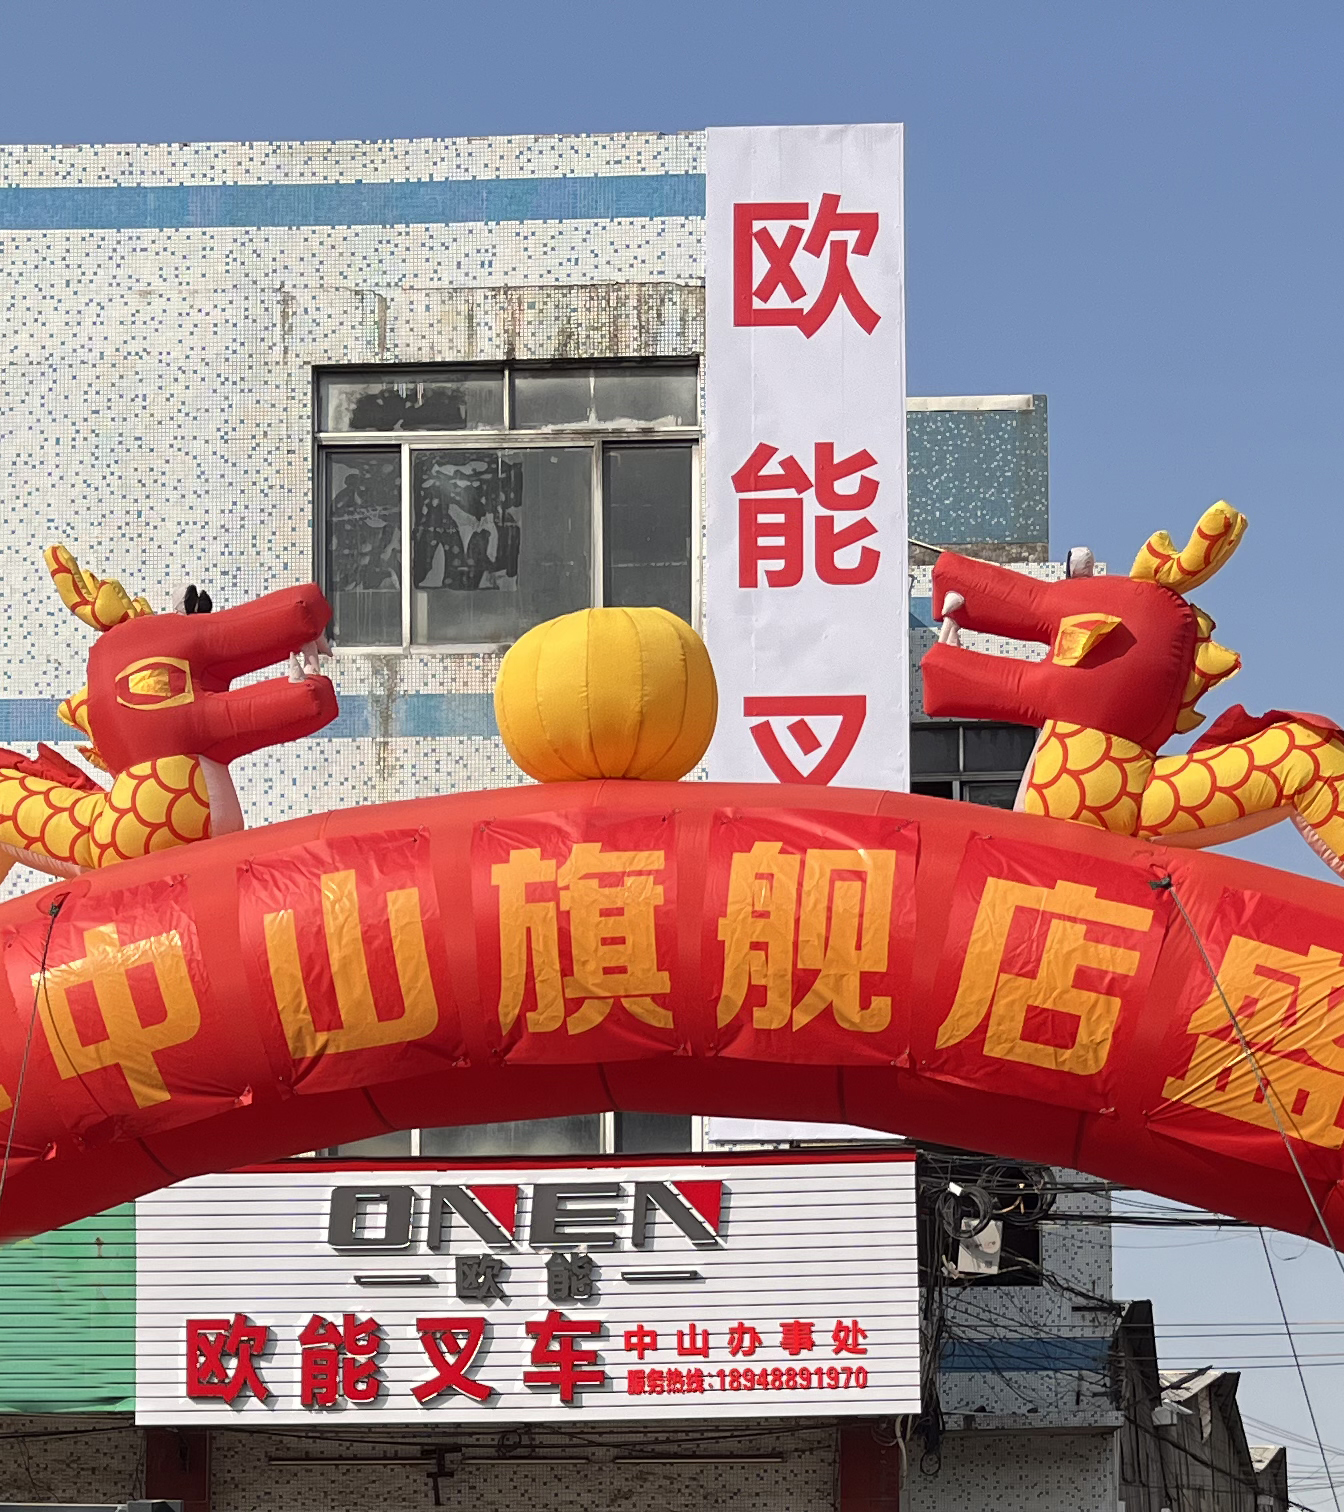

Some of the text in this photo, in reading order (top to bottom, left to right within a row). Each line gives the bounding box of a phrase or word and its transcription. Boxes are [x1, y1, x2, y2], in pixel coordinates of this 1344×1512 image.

[327, 1180, 723, 1250] ONEN
[455, 1252, 599, 1305] 欧能
[185, 1309, 607, 1408] 欧能叉车
[623, 1319, 868, 1361] 中山办事处
